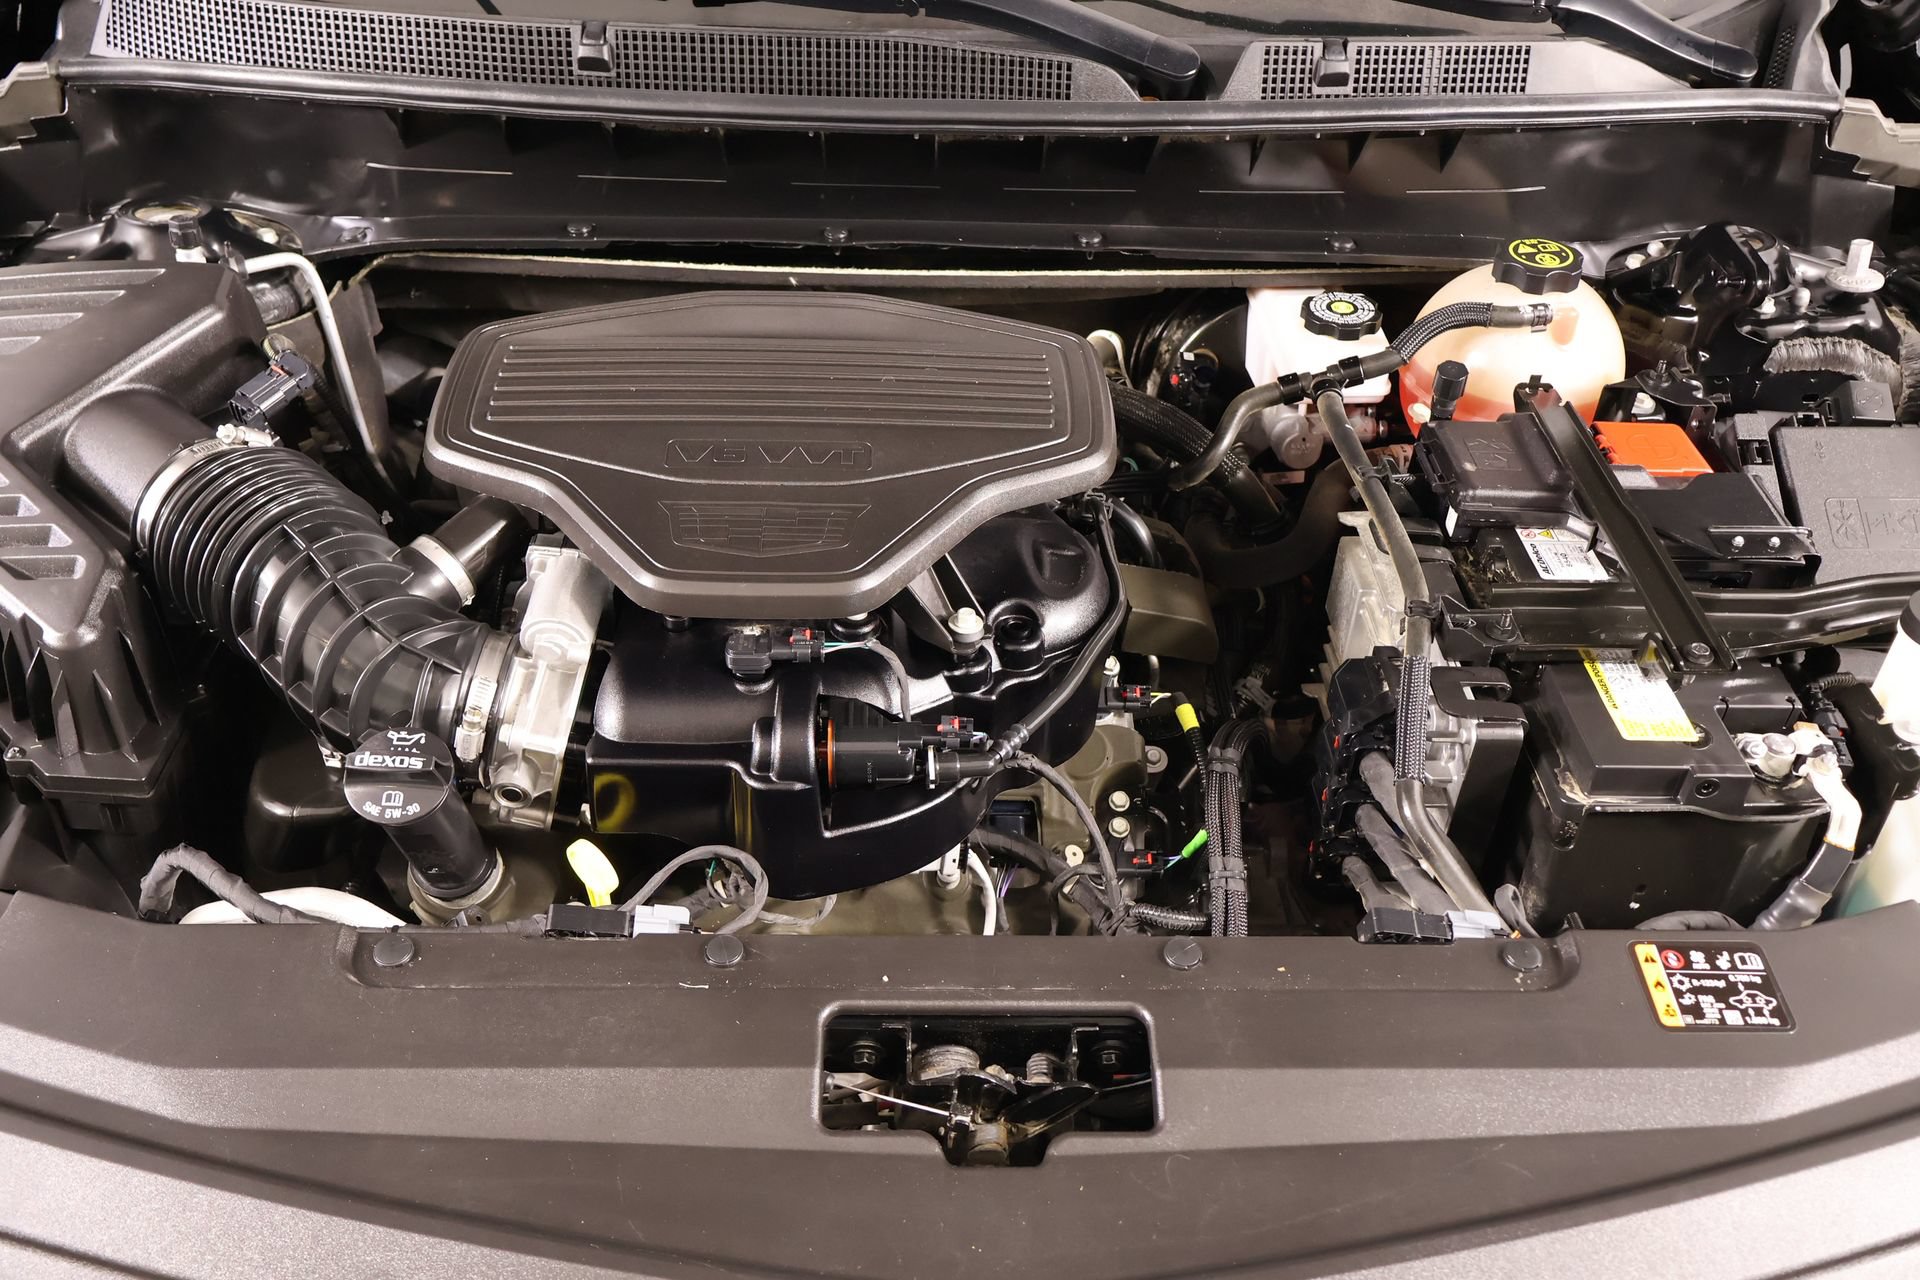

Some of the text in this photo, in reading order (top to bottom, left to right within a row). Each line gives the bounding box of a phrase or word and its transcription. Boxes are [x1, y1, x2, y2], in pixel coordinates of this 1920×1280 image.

[674, 444, 865, 465] V6 VVT
[1530, 543, 1551, 575] ACDelco
[1598, 678, 1614, 705] DANGER
[354, 751, 427, 769] dexos
[363, 801, 421, 819] SAE 5W-30
